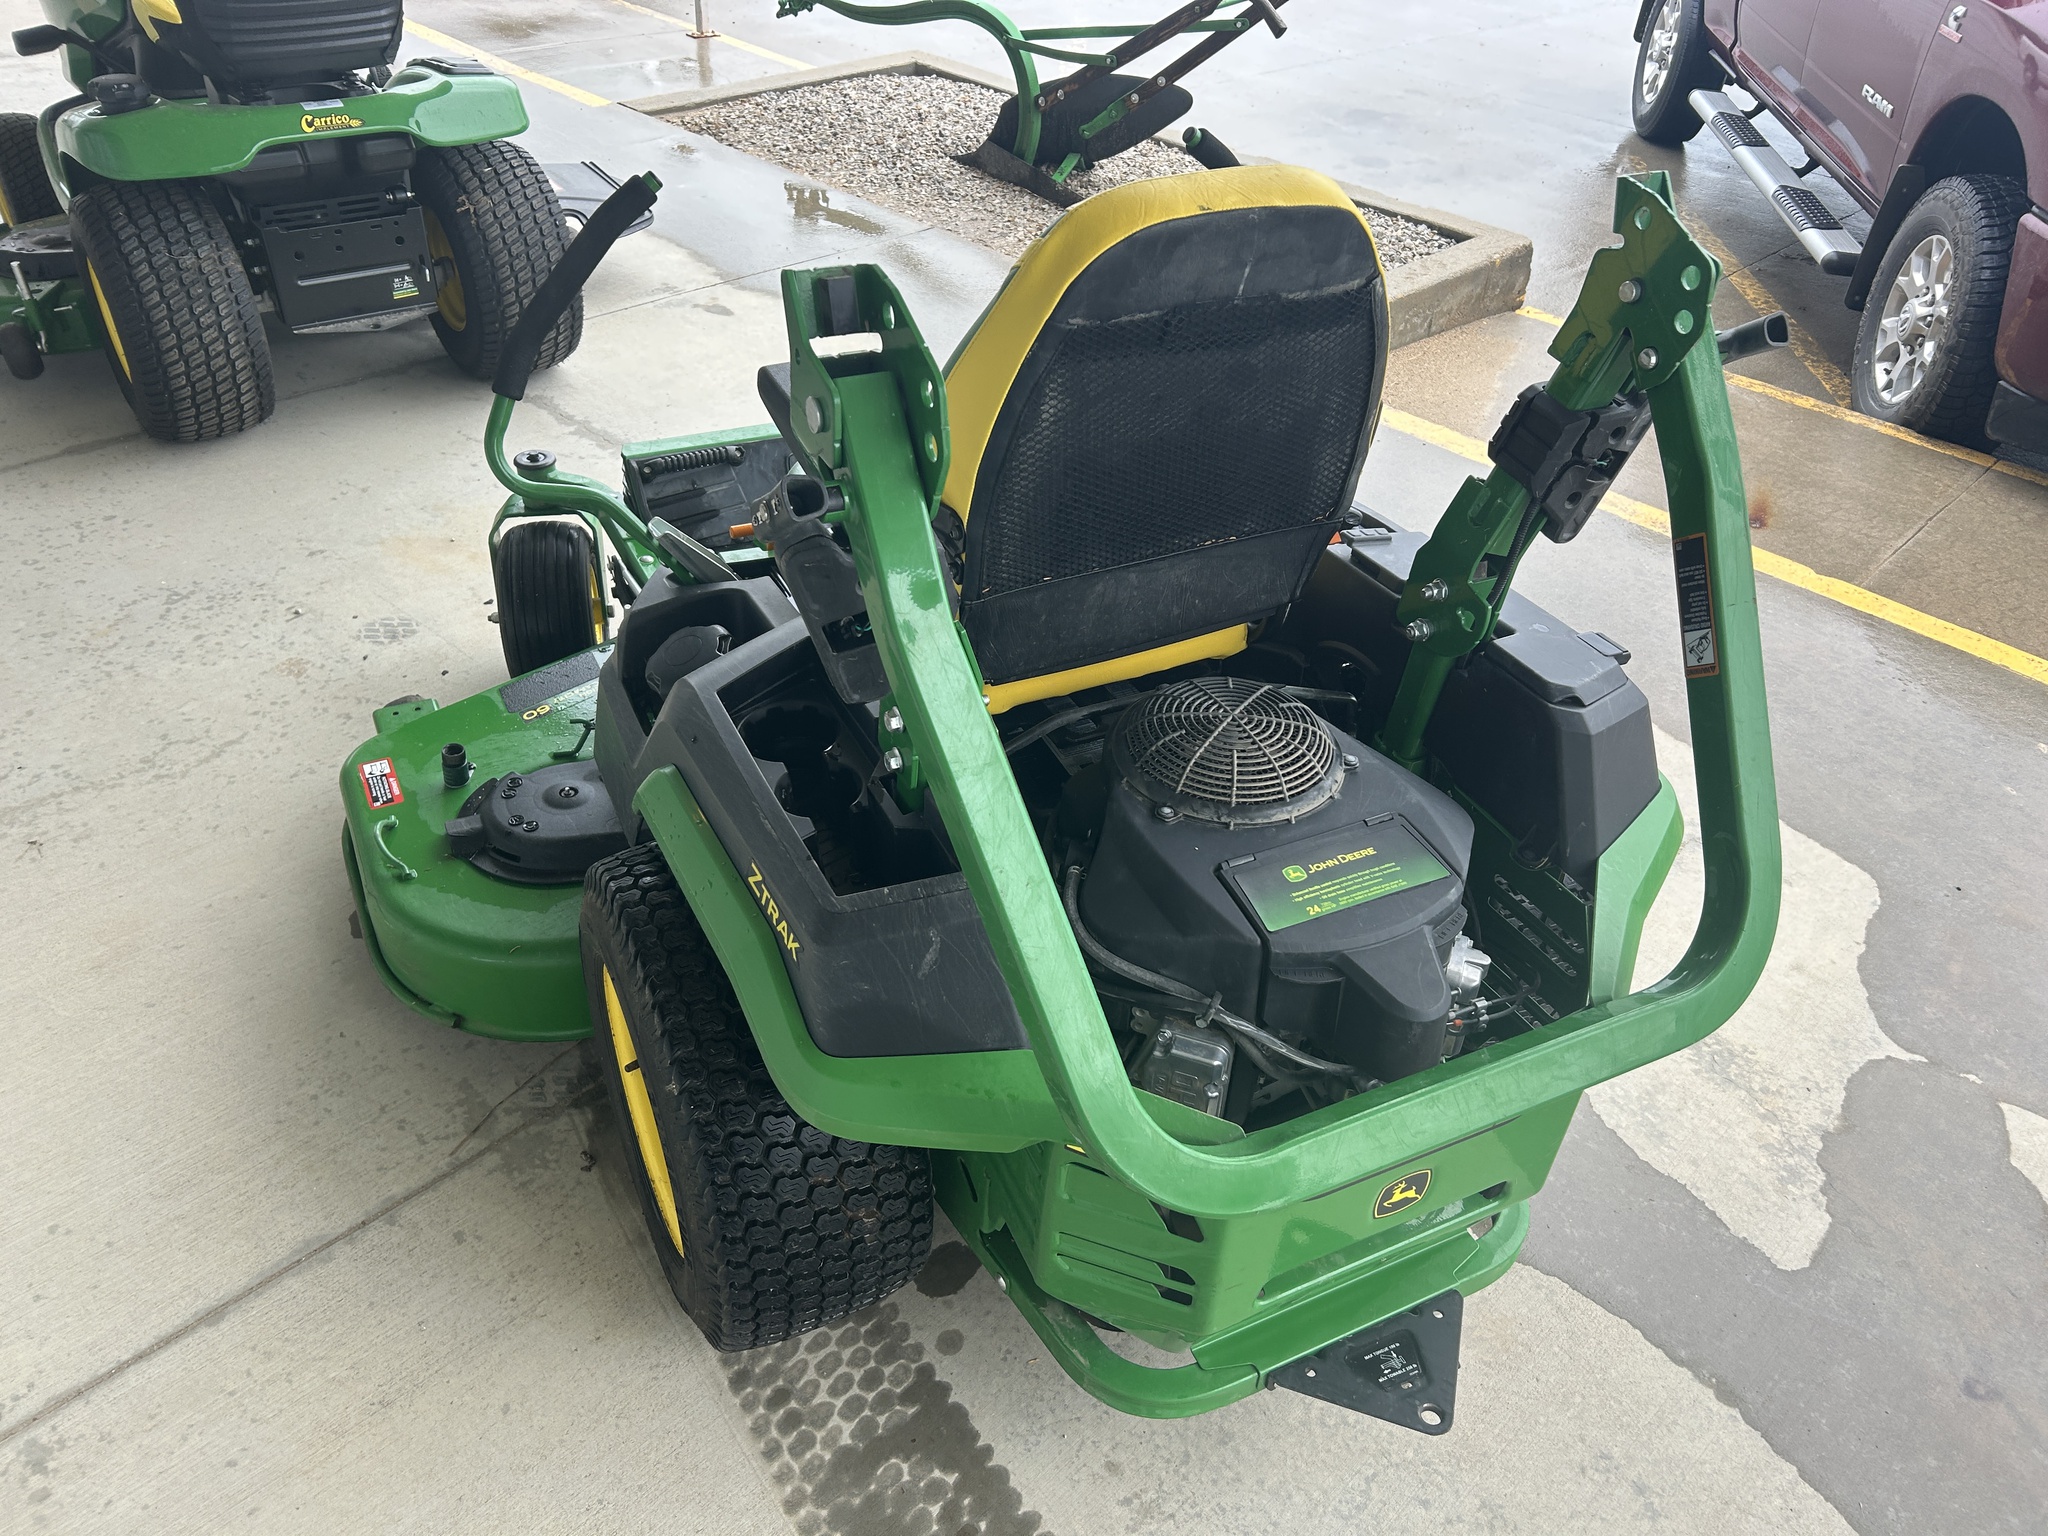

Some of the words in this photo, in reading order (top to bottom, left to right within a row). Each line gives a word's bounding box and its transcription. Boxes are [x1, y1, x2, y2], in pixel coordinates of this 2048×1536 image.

[1861, 83, 1894, 119] RAM
[301, 113, 350, 133] Carrico
[522, 704, 551, 720] 60
[1308, 858, 1339, 874] JOHN
[1337, 847, 1377, 864] DEERE
[747, 862, 800, 962] ZTRAK
[1306, 904, 1322, 916] 24
